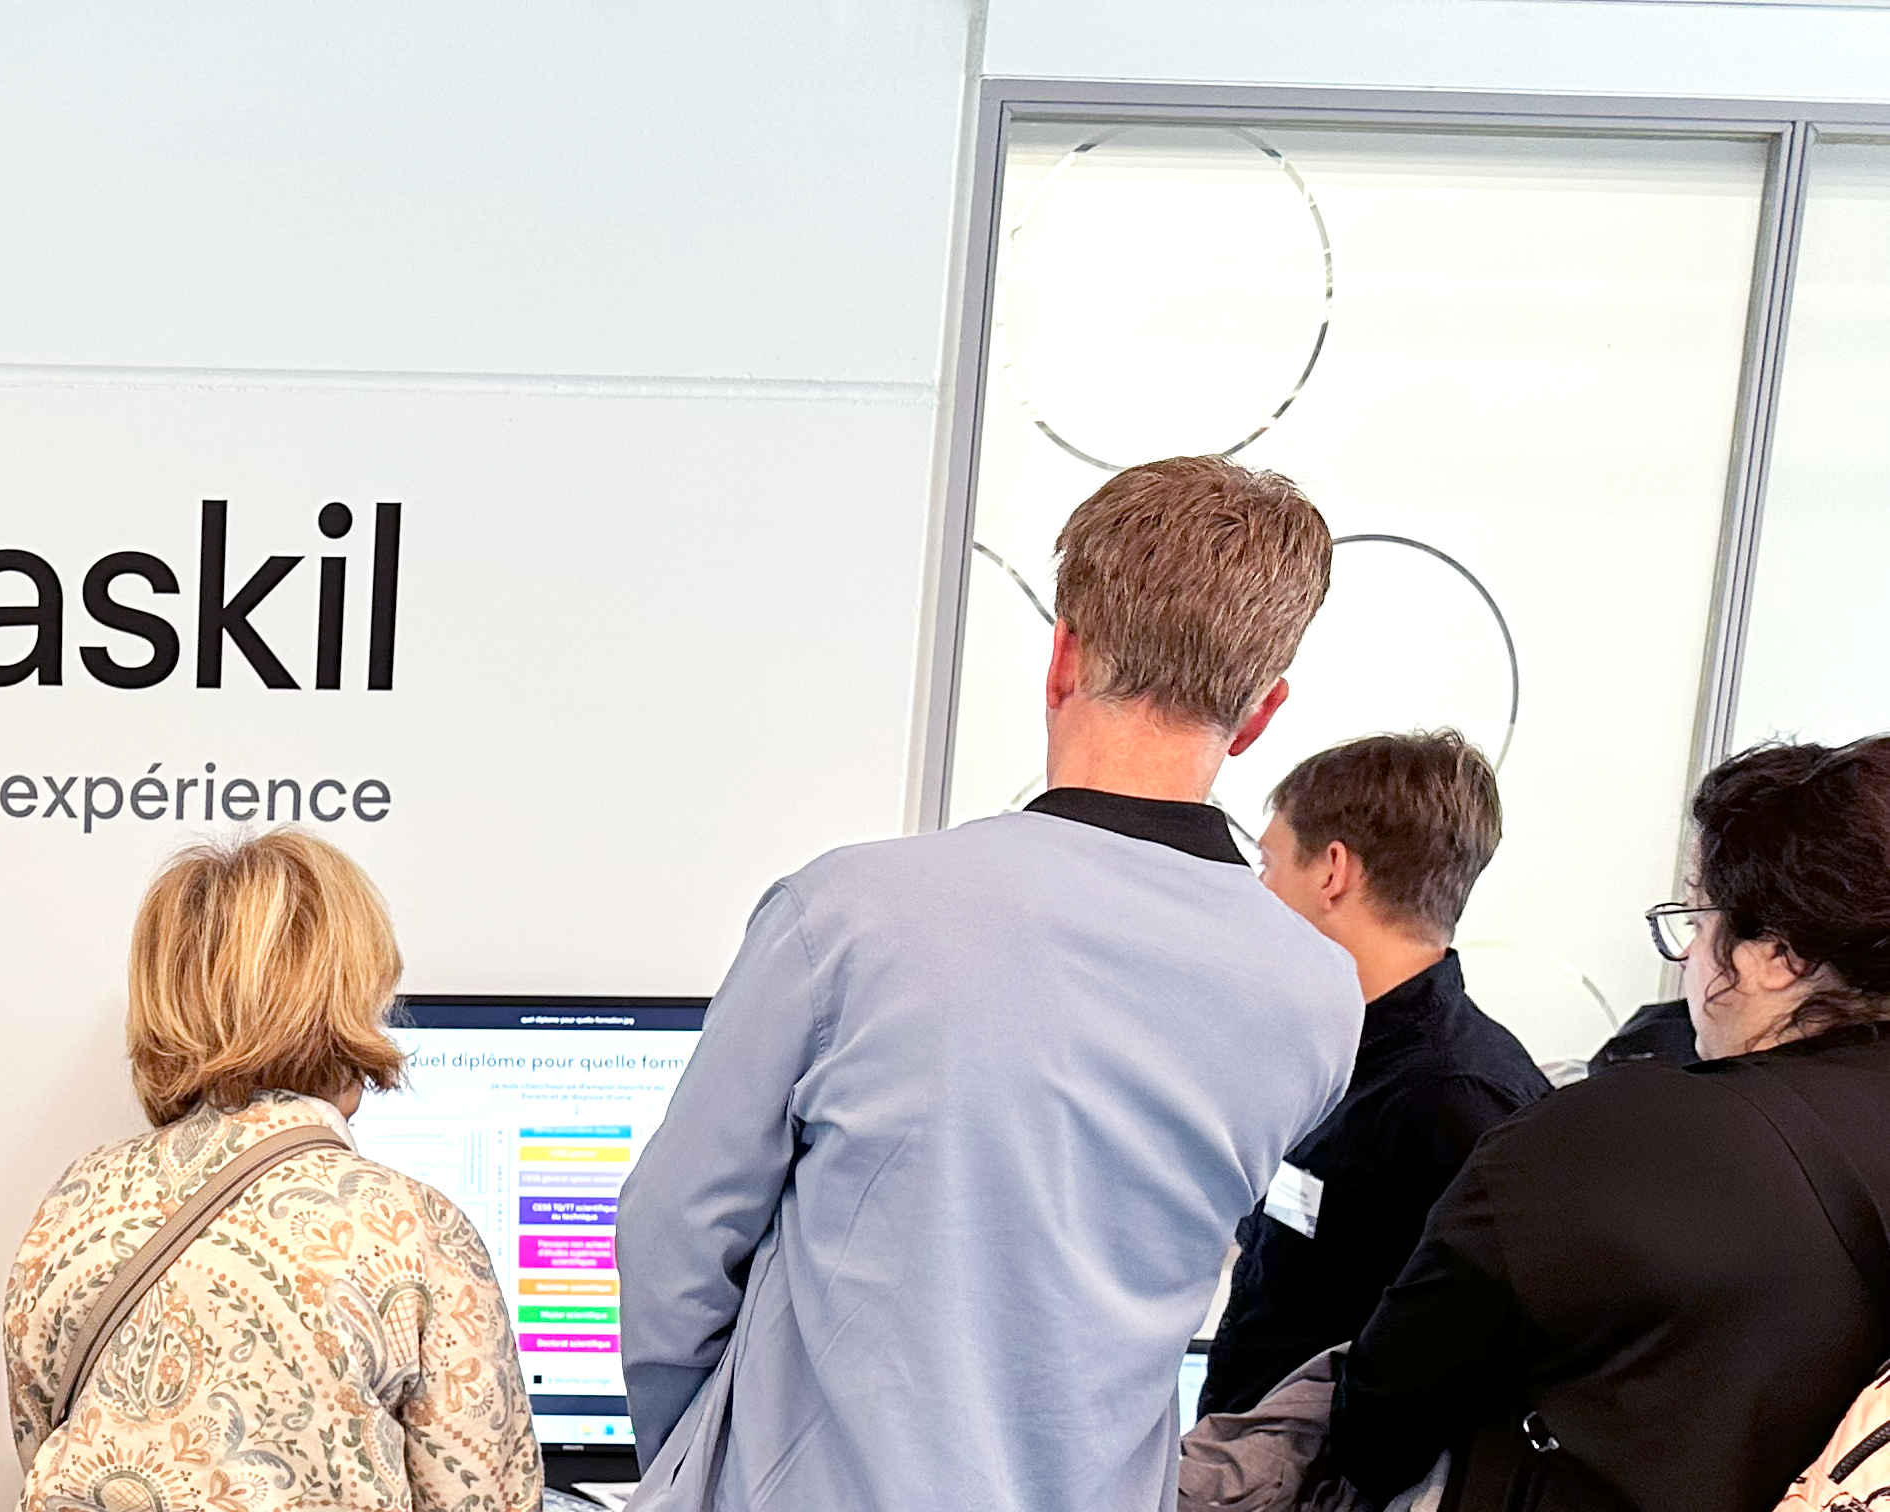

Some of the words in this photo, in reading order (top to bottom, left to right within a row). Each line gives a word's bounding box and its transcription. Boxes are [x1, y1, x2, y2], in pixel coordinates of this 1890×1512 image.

[0, 763, 392, 833] expérience
[452, 1052, 526, 1071] diplôme
[532, 1057, 575, 1072] pour
[580, 1054, 636, 1072] quelle
